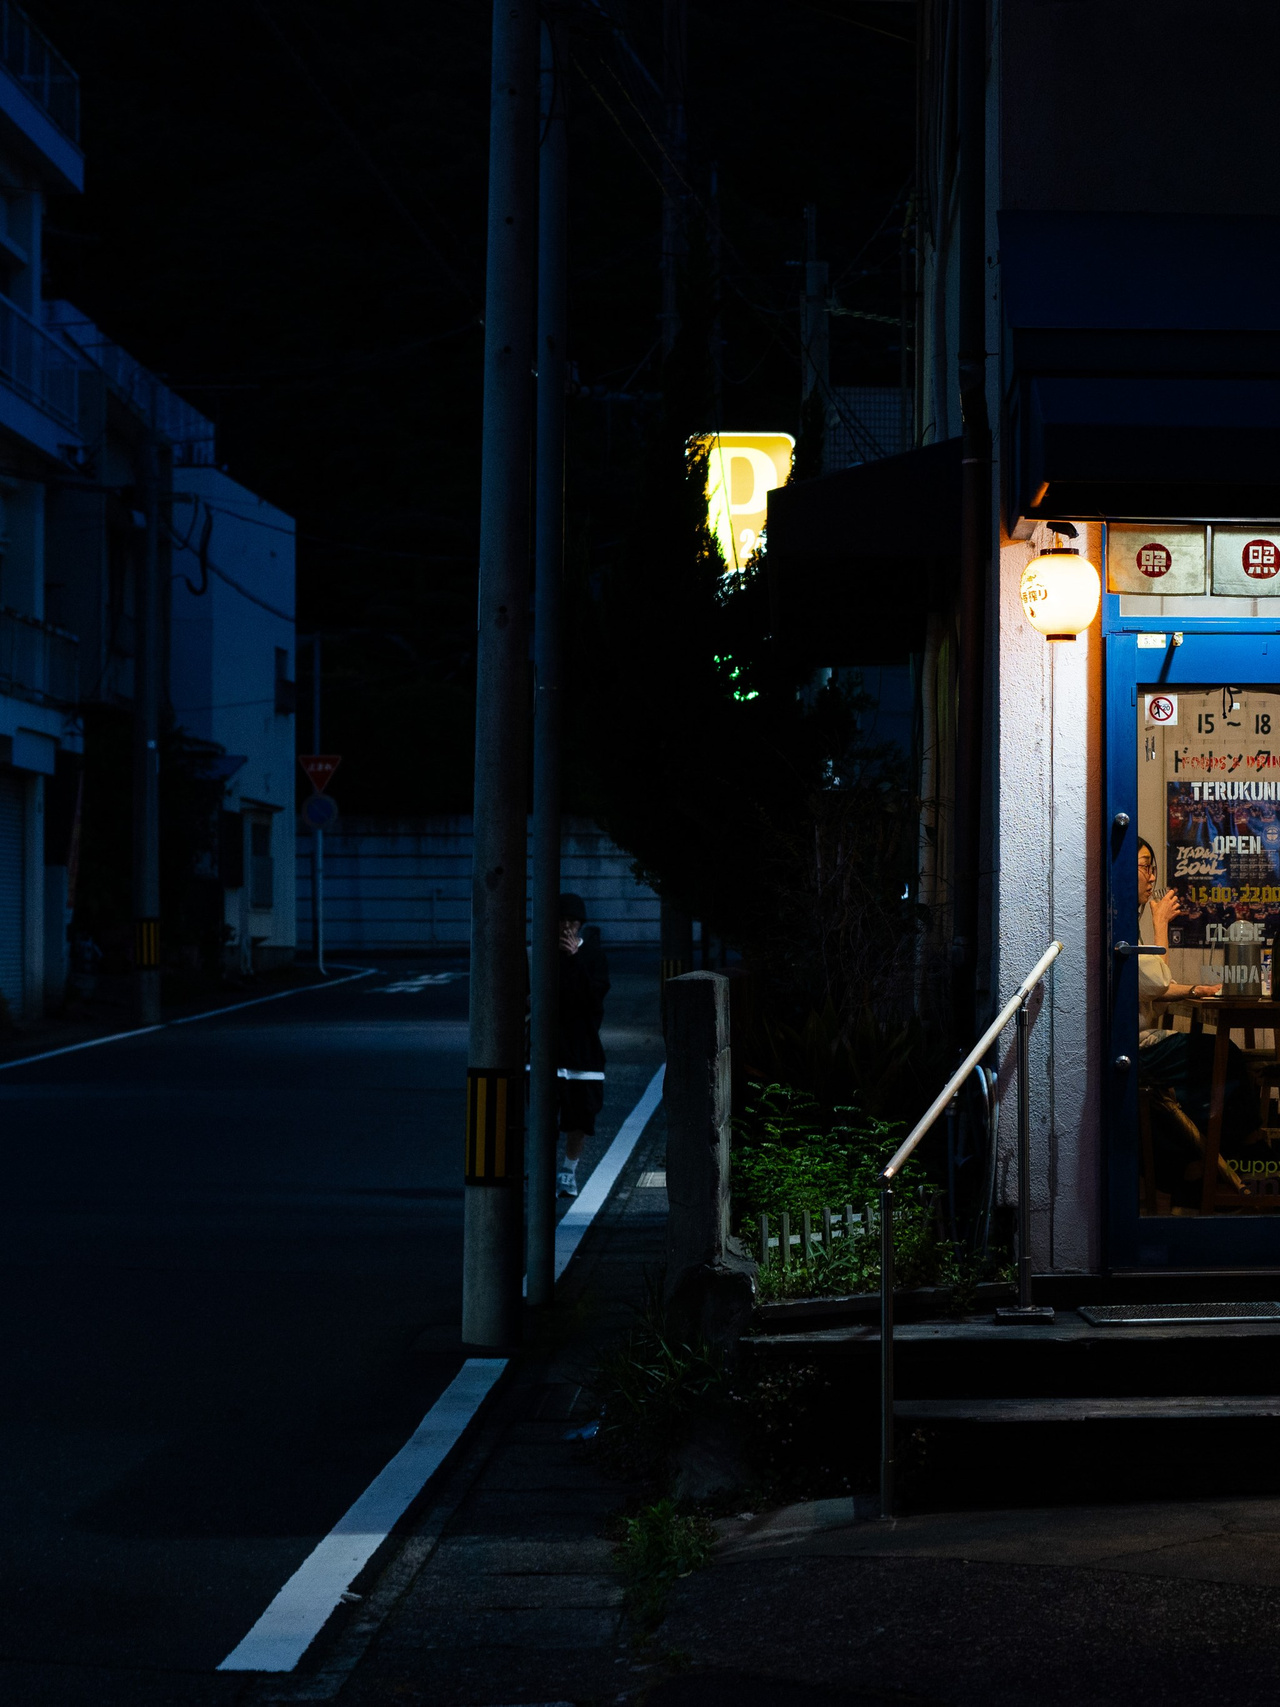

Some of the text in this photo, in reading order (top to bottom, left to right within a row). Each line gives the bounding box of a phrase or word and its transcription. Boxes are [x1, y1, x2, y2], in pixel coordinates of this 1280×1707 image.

[708, 446, 778, 562] P
[1140, 550, 1167, 572] 照
[1248, 546, 1276, 574] 照
[1213, 835, 1262, 854] OPEN
[1174, 859, 1227, 877] SOUL
[1206, 923, 1266, 942] CLOSE
